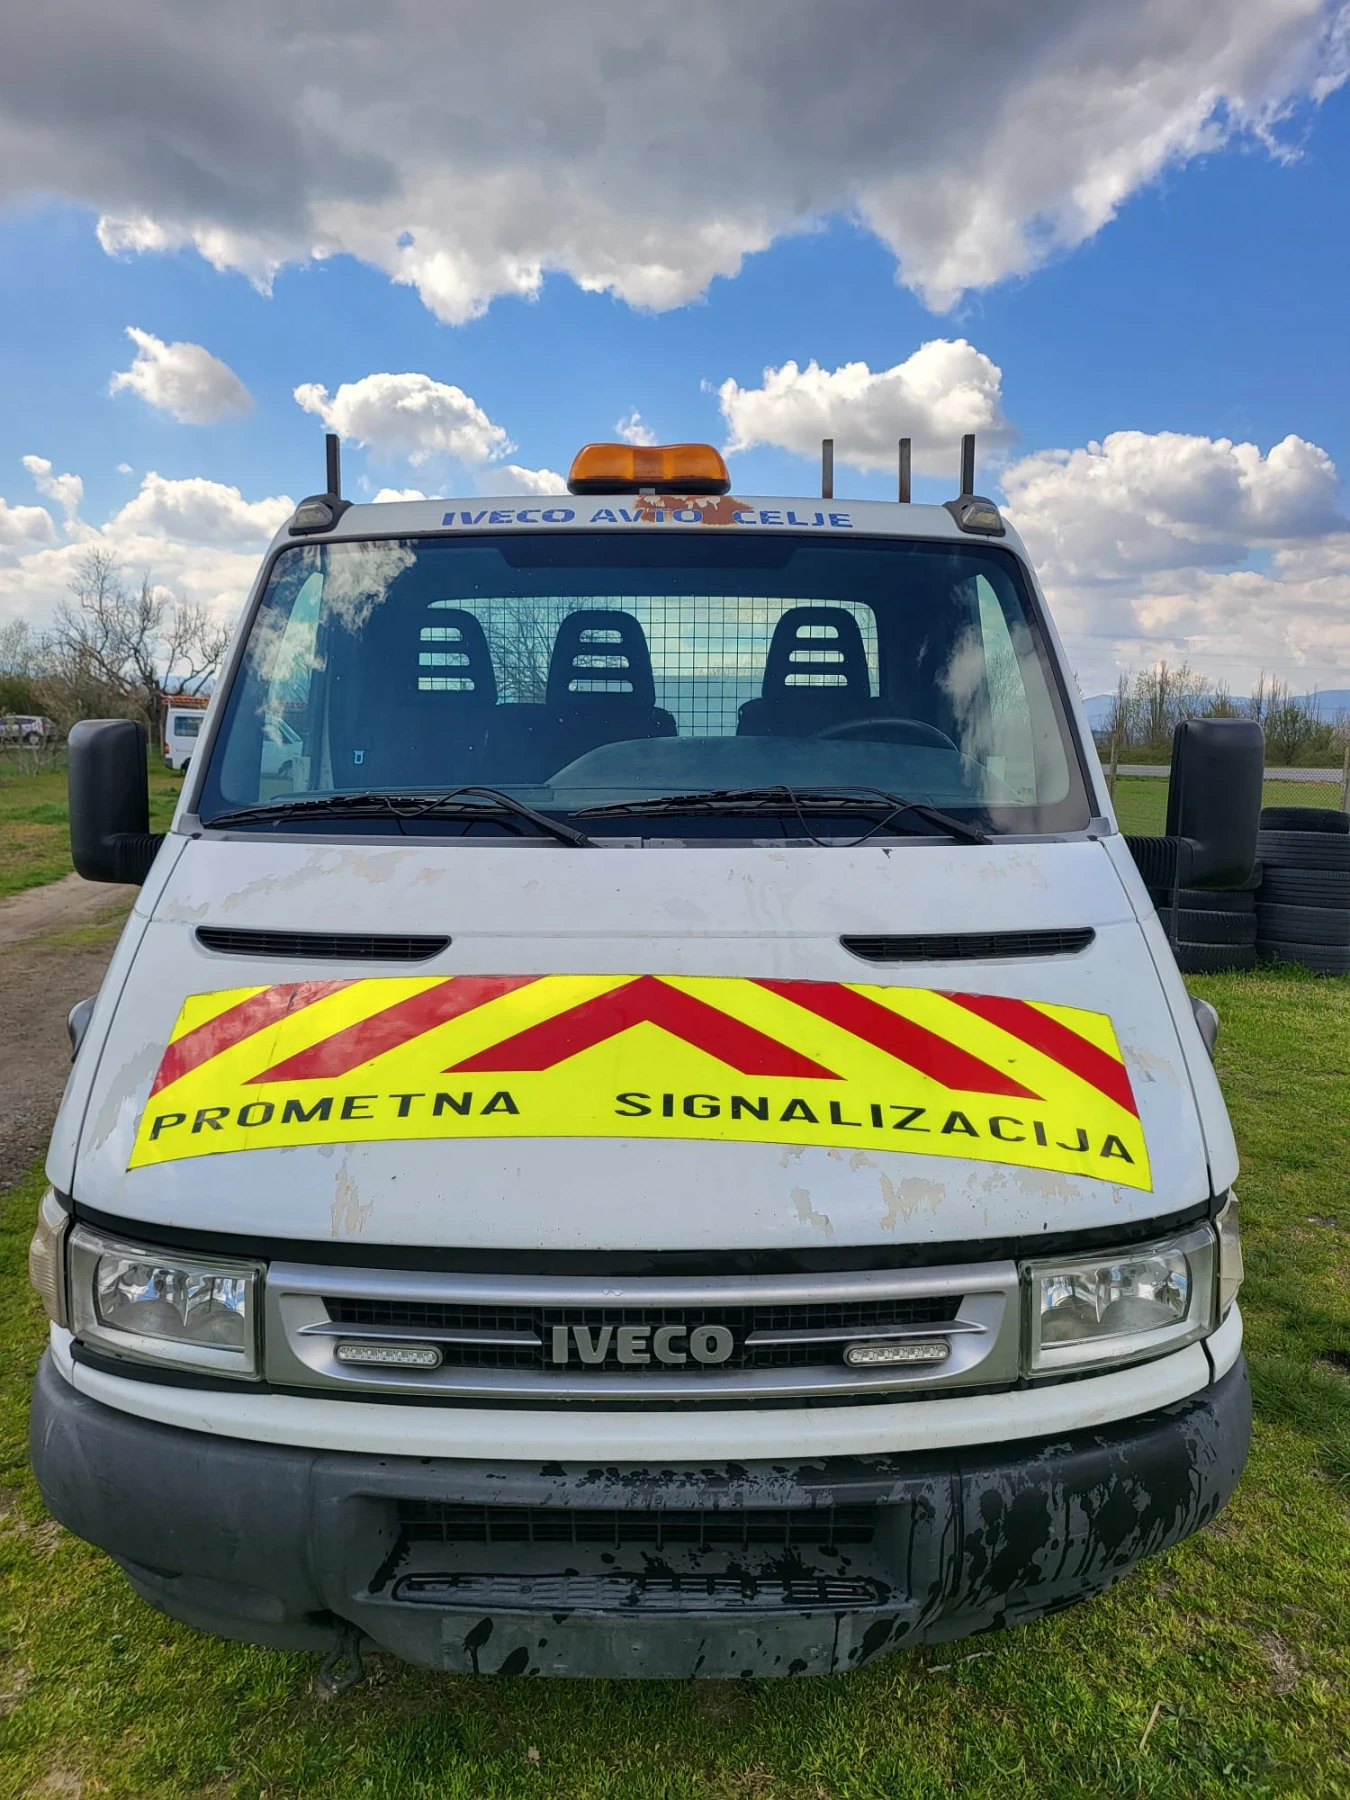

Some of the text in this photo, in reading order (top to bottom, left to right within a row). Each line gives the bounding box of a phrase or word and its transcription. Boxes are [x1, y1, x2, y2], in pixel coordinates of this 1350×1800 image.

[441, 508, 854, 528] IVECO AVTO CELJE
[148, 1091, 1136, 1165] PROMETNA SIGNALIZACIJA
[552, 1324, 734, 1364] IVECO
